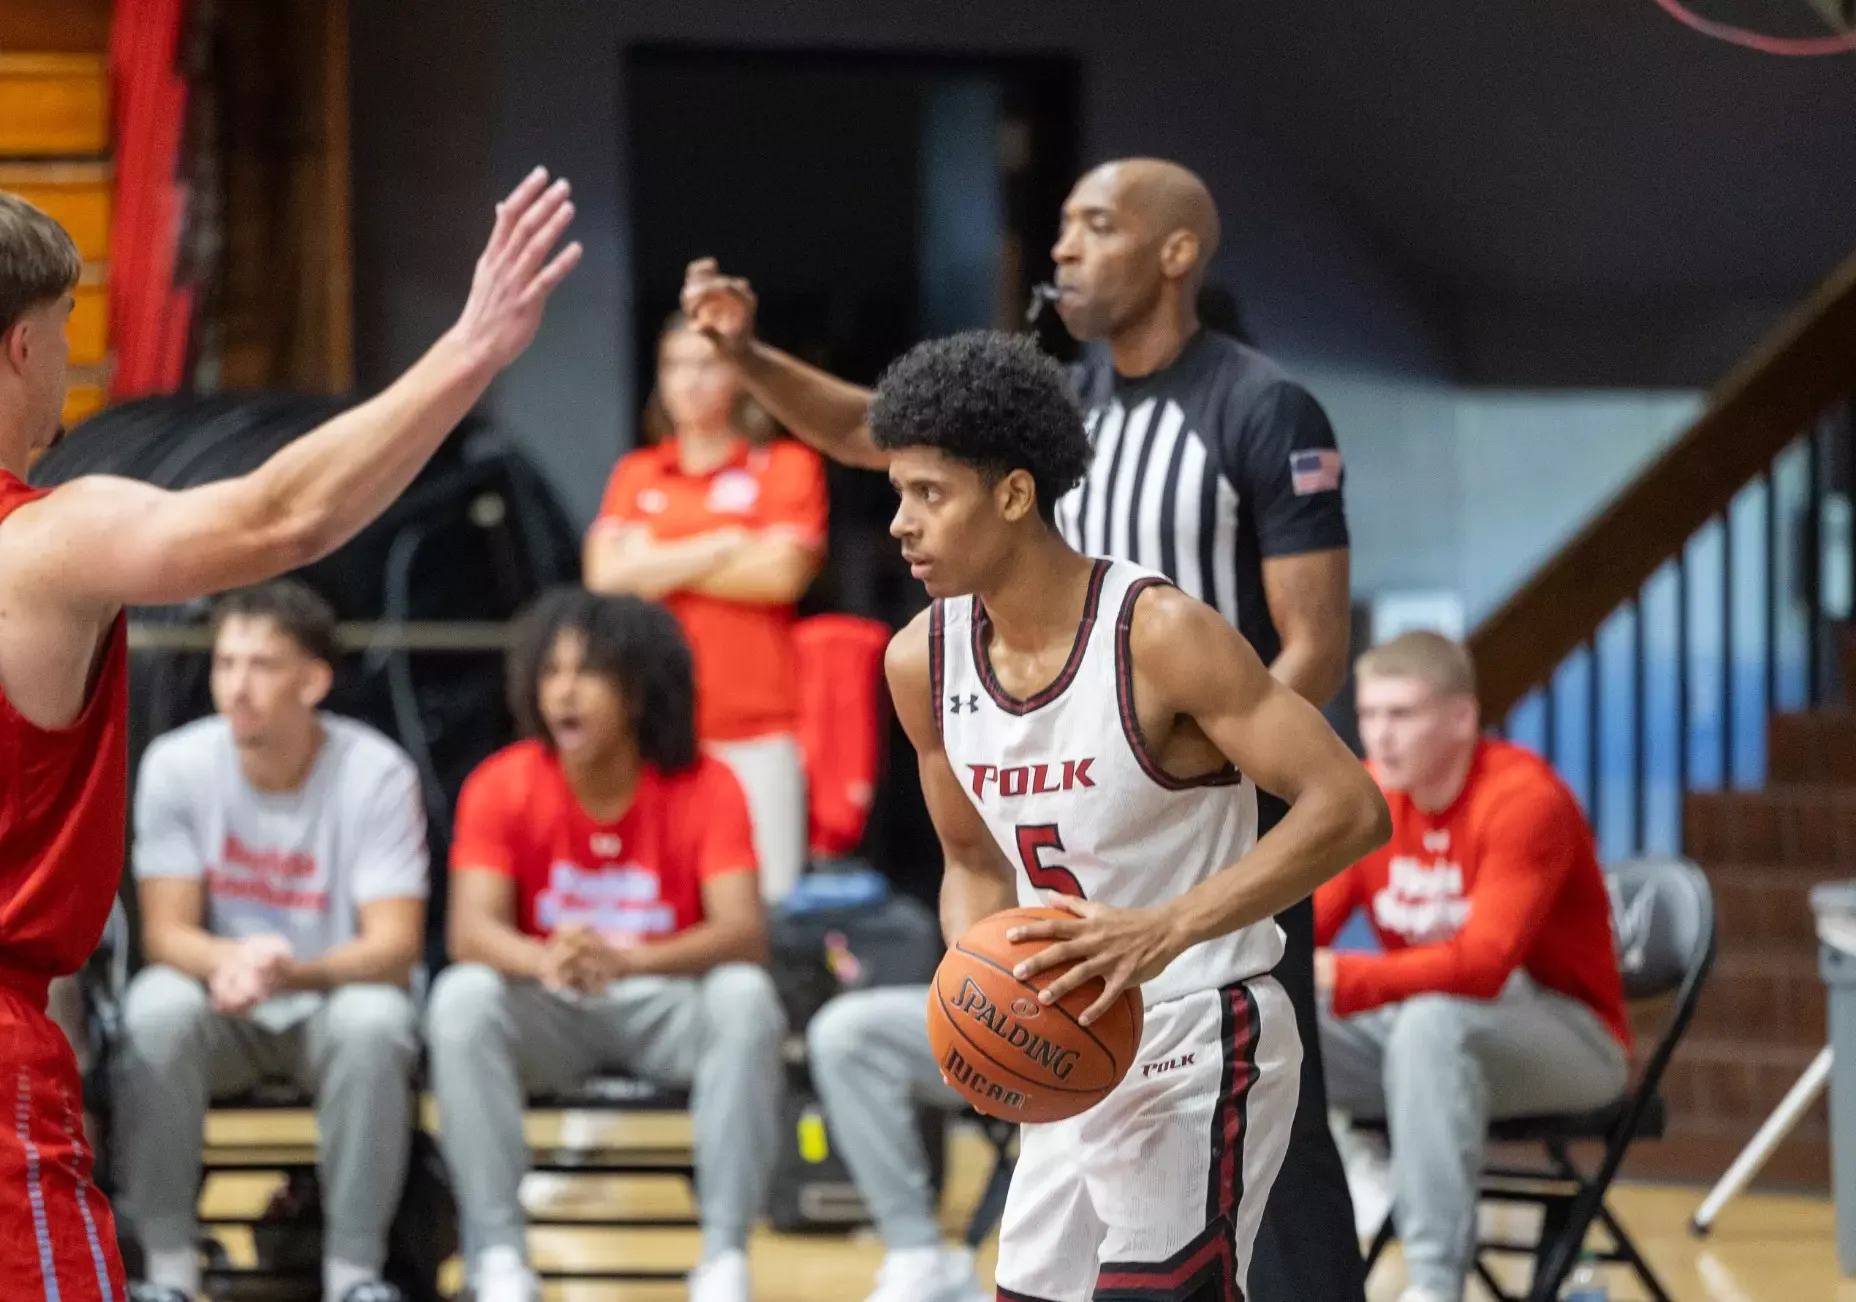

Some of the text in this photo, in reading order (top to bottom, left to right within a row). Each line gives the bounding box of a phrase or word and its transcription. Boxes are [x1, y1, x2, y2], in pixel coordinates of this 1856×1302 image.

[966, 757, 1096, 802] POLK
[1015, 823, 1087, 901] 5
[950, 975, 1082, 1081] SPALDING
[1141, 1052, 1195, 1078] POLK
